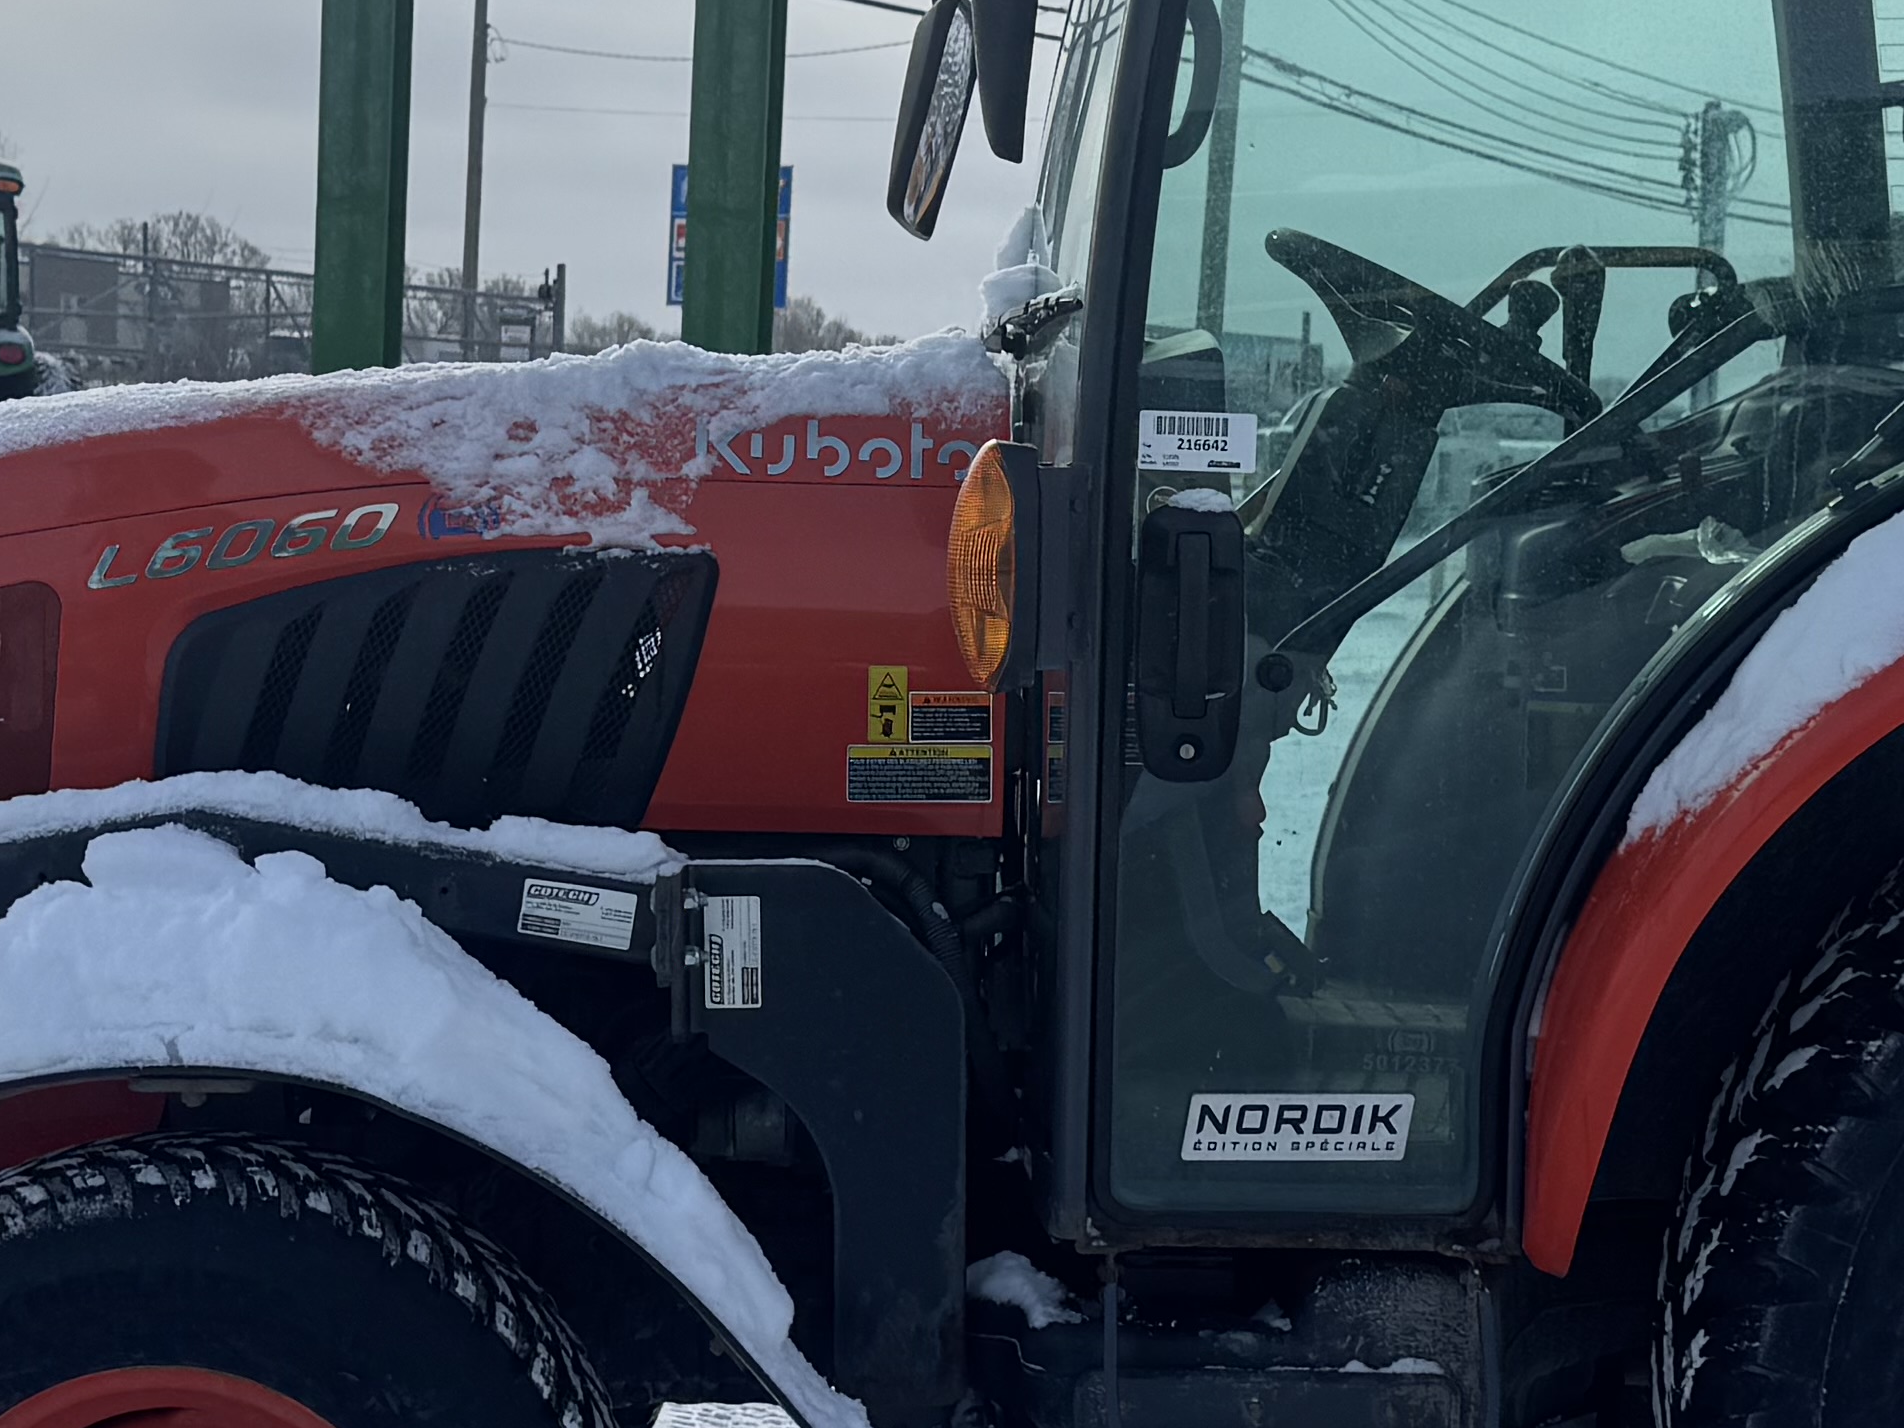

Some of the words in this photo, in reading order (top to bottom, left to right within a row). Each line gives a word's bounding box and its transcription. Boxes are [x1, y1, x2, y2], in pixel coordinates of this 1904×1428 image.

[1177, 438, 1229, 452] 216642
[87, 503, 400, 589] L6060
[1196, 1104, 1403, 1135] NORDIK
[1193, 1138, 1278, 1151] ÉDITION
[1291, 1138, 1396, 1151] SPÉCIALE
